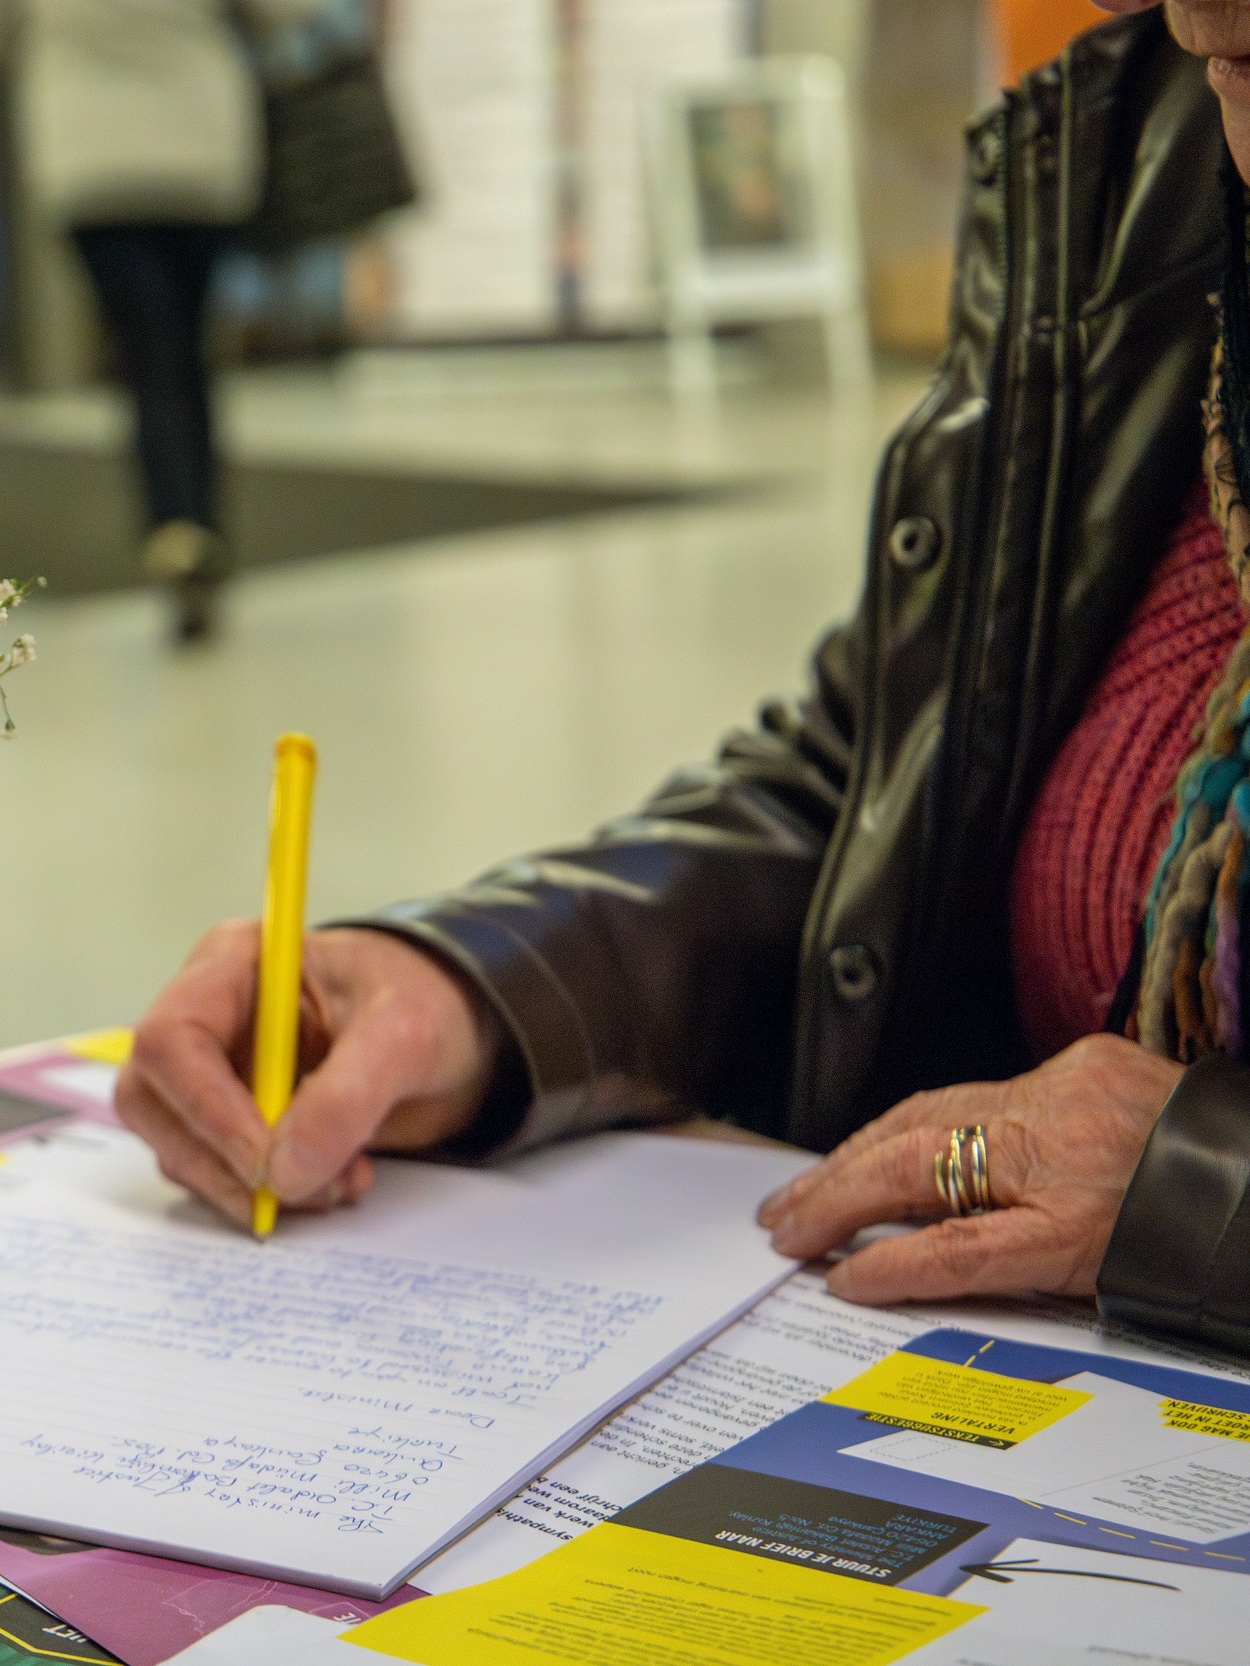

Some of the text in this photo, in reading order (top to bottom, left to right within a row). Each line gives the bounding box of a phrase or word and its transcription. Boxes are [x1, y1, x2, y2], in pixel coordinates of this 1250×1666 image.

[1162, 1410, 1193, 1419] HET
[930, 1411, 1016, 1435] VERTALING
[1169, 1419, 1199, 1430] OOK
[1212, 1419, 1250, 1431] ROET
[1200, 1425, 1234, 1437] MAG
[549, 1481, 580, 1496] een
[575, 1494, 623, 1512] chrijf
[523, 1498, 594, 1528] werk van
[714, 1530, 892, 1578] STUUR JE BRIEF NAAR
